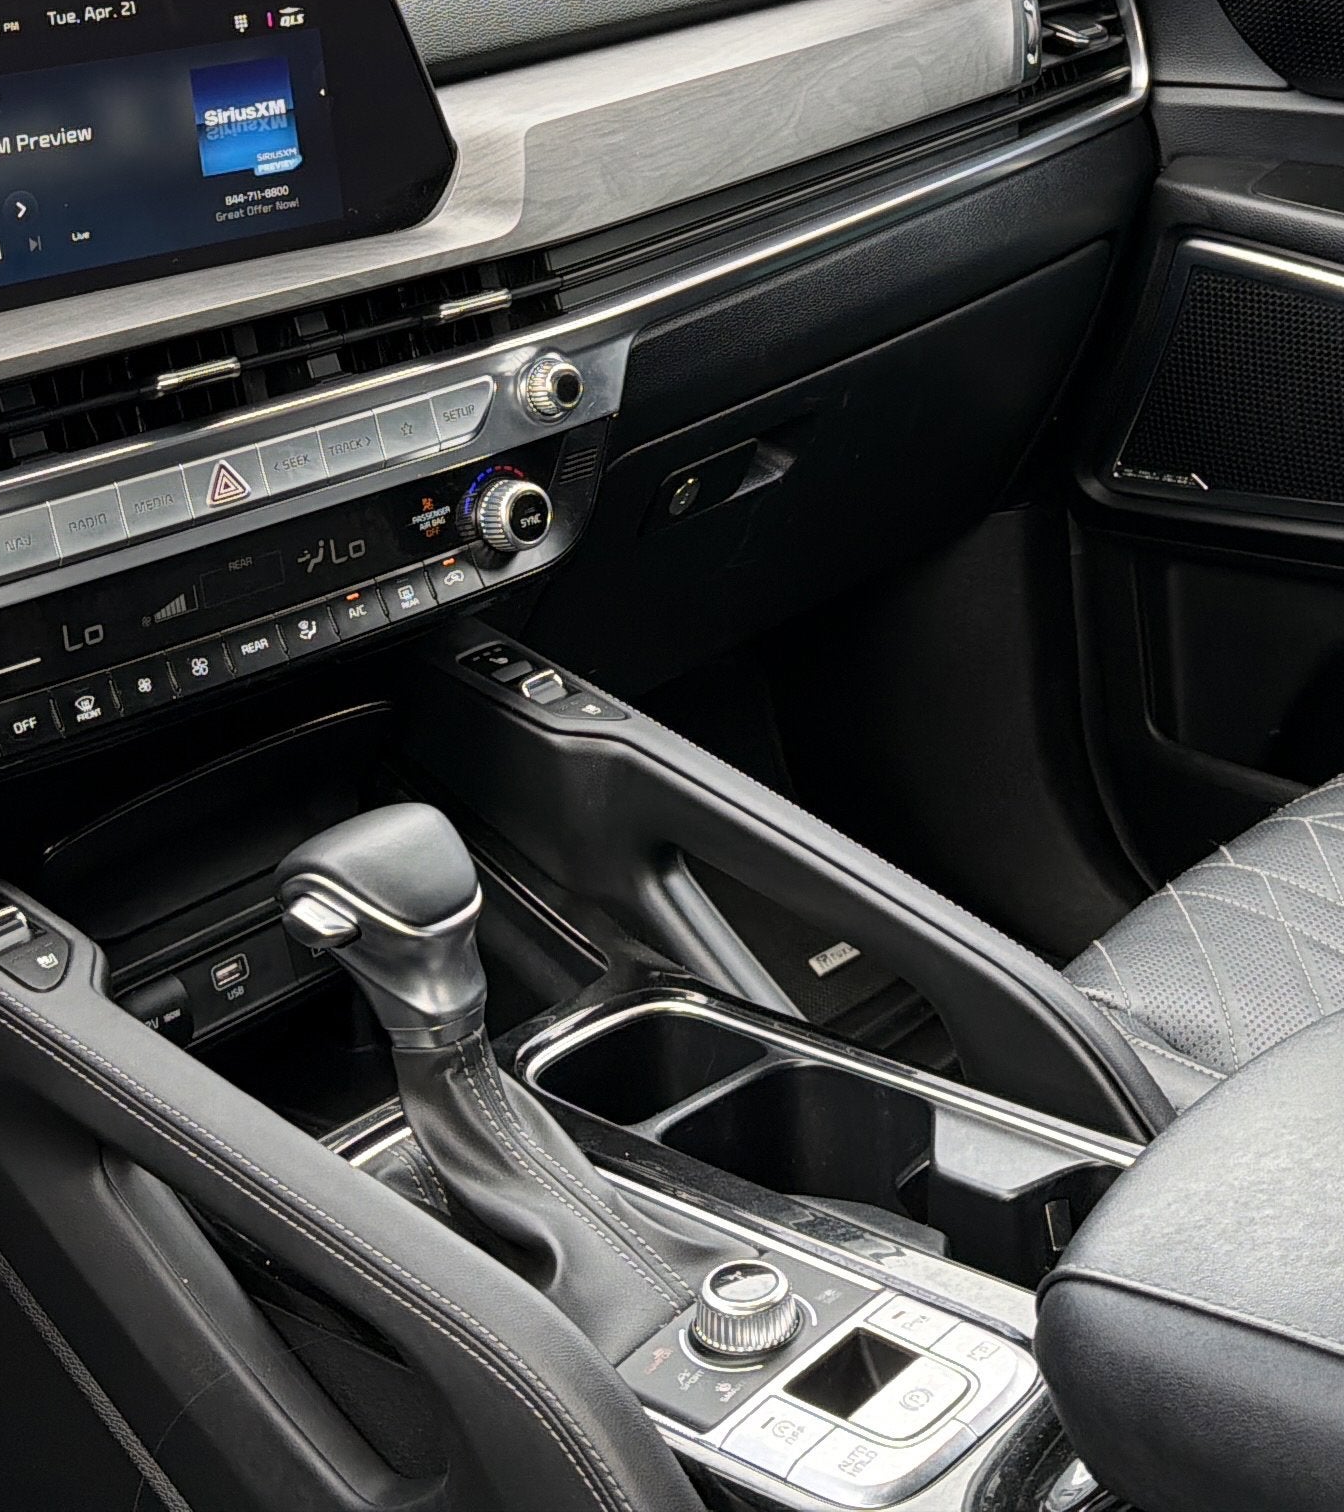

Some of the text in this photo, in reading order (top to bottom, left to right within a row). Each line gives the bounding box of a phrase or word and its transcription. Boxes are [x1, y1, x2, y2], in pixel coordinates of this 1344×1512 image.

[84, 6, 118, 22] Apr.
[120, 0, 137, 17] 21
[3, 21, 20, 33] PM
[204, 98, 287, 127] SiriusXM
[16, 127, 93, 152] Preview
[215, 200, 300, 223] Great Offer Now!
[442, 404, 475, 423] SETUP
[327, 439, 363, 458] TRACK
[282, 454, 311, 471] SEEK
[134, 493, 174, 515] MEDIA
[68, 512, 107, 533] RADIO
[412, 506, 451, 525] PASSENGER
[520, 513, 542, 529] SYNC
[5, 535, 32, 553] NAV
[348, 606, 368, 619] A/C
[62, 623, 104, 652] Lo
[241, 637, 269, 656] REAR
[76, 707, 102, 723] FRONT
[12, 716, 37, 735] OFF
[226, 986, 245, 1001] USB
